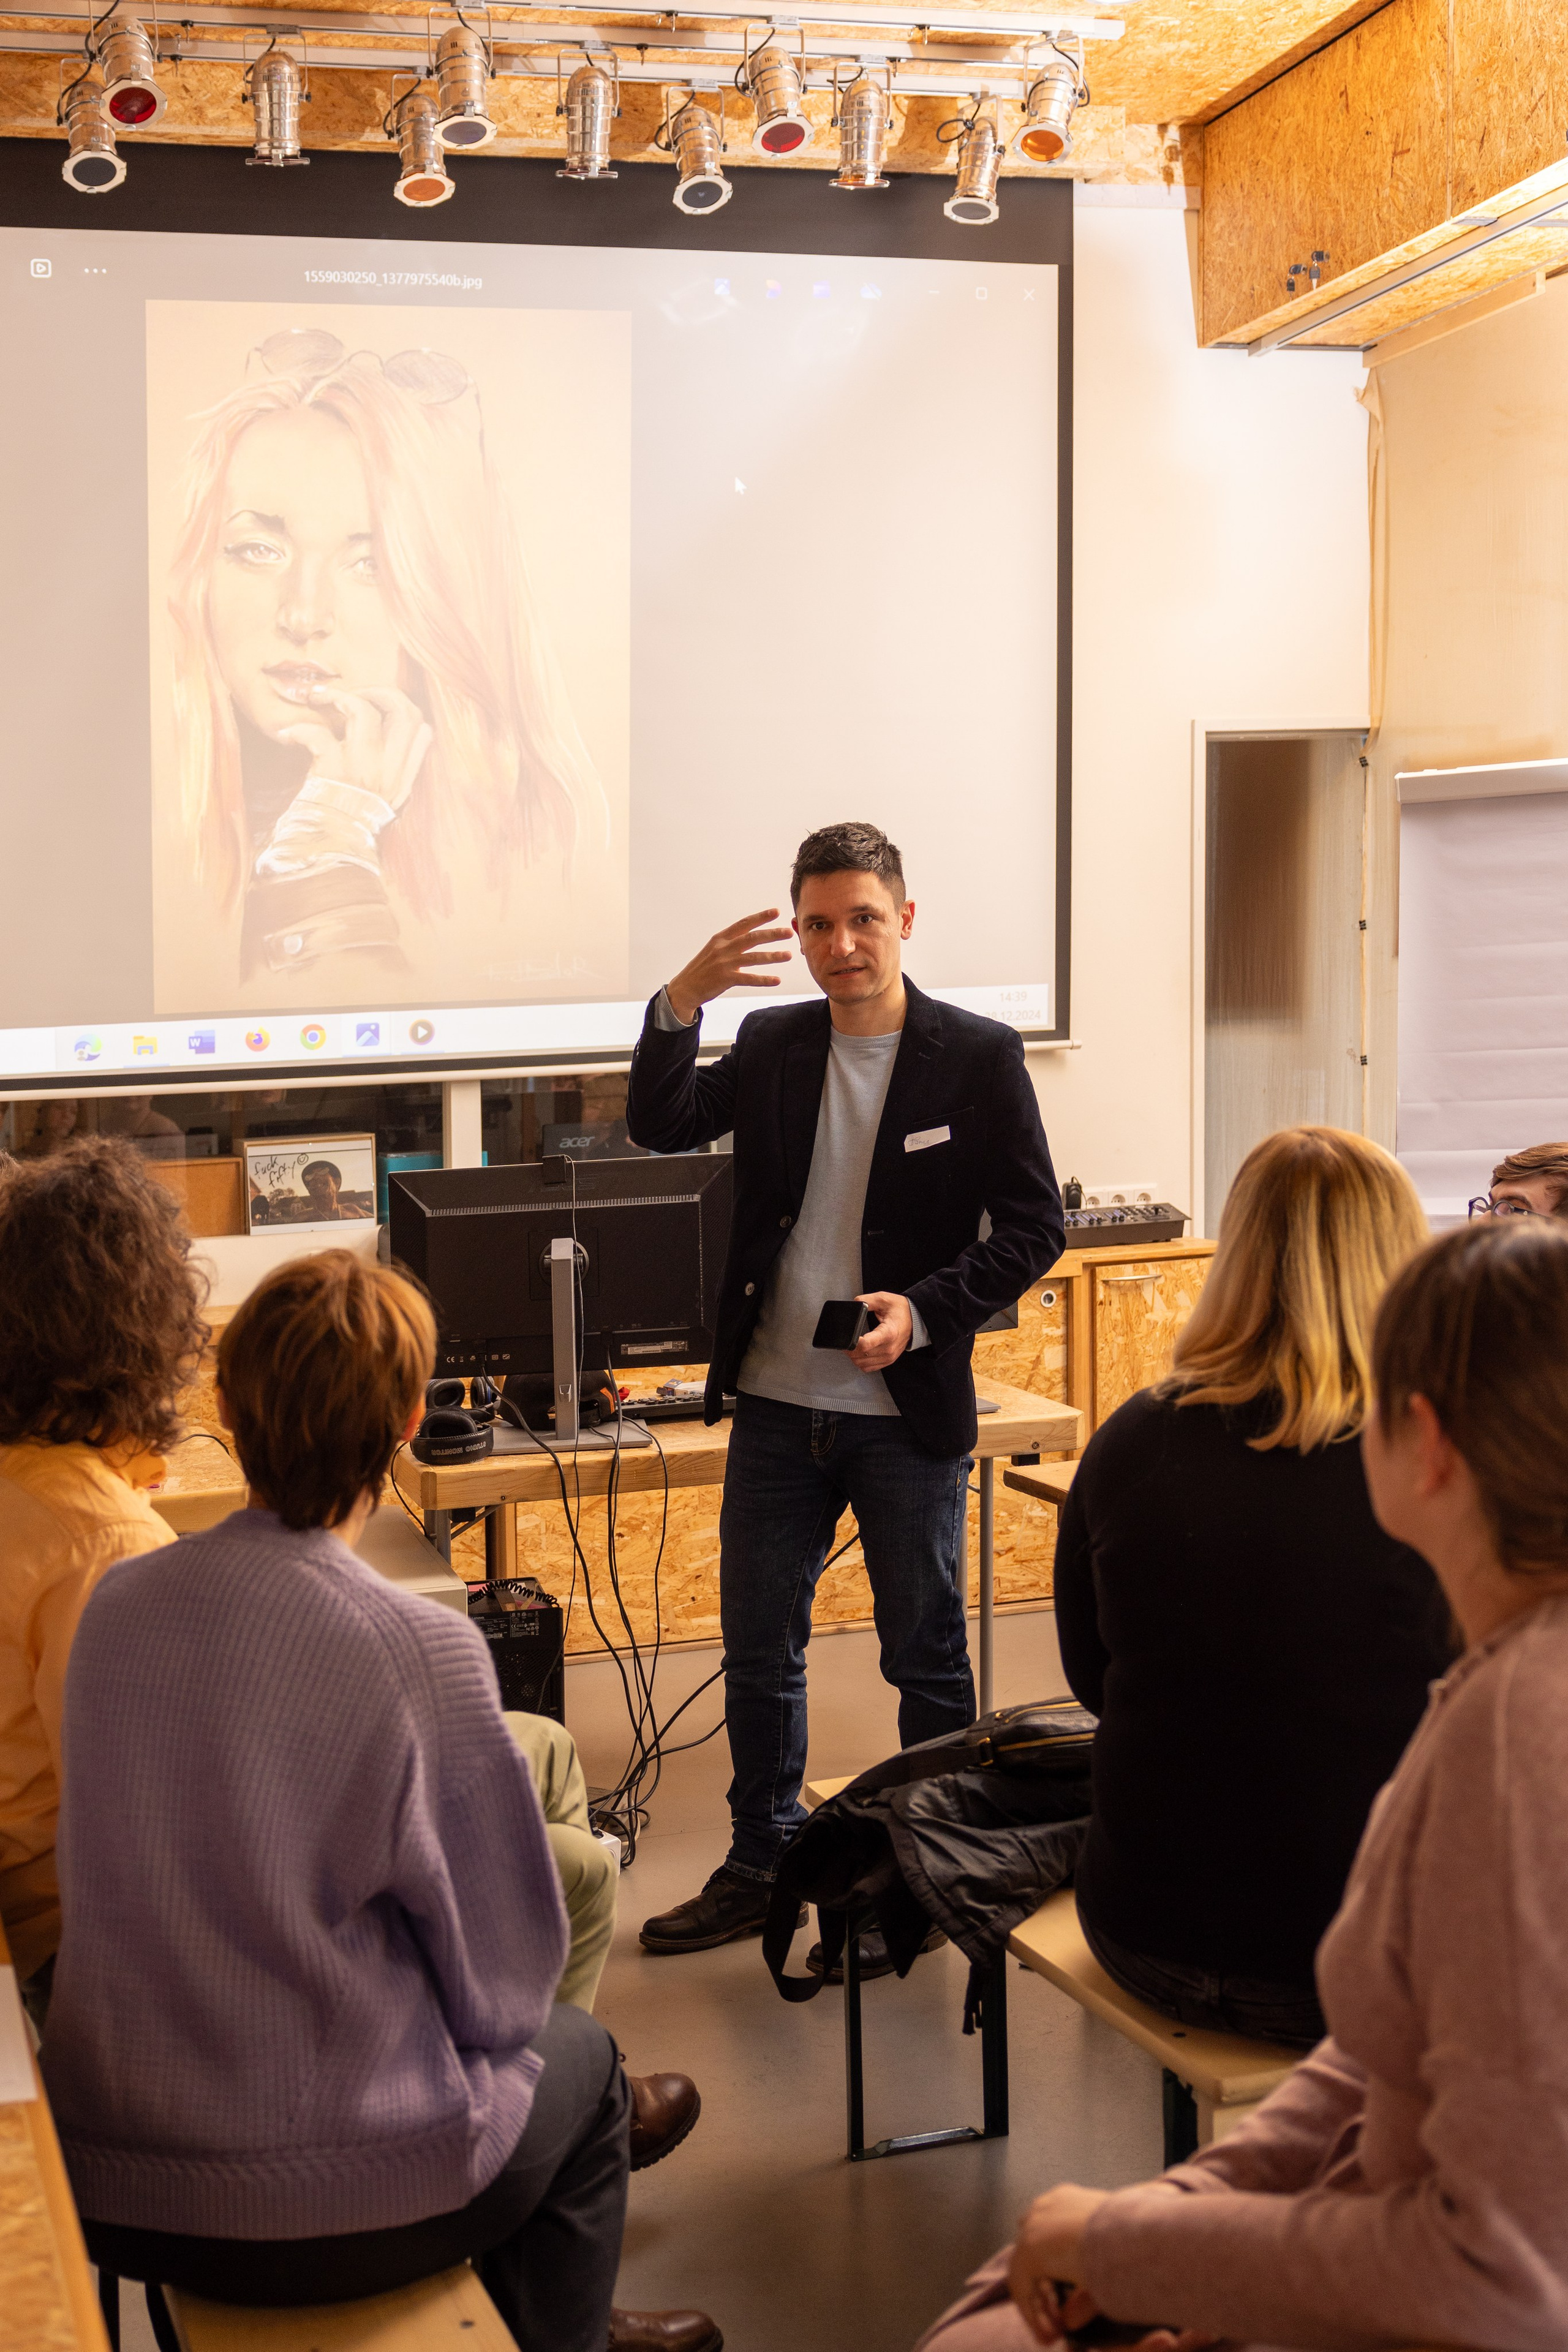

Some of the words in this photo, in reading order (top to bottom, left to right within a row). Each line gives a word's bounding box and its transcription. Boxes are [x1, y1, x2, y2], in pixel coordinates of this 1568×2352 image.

[304, 270, 482, 289] 1559030250_1377975540b.jpg
[1000, 991, 1027, 1003] 14:39
[190, 1038, 201, 1047] W
[559, 1136, 595, 1148] acer
[431, 1447, 463, 1456] MONITOR
[466, 1441, 486, 1452] STUDIO
